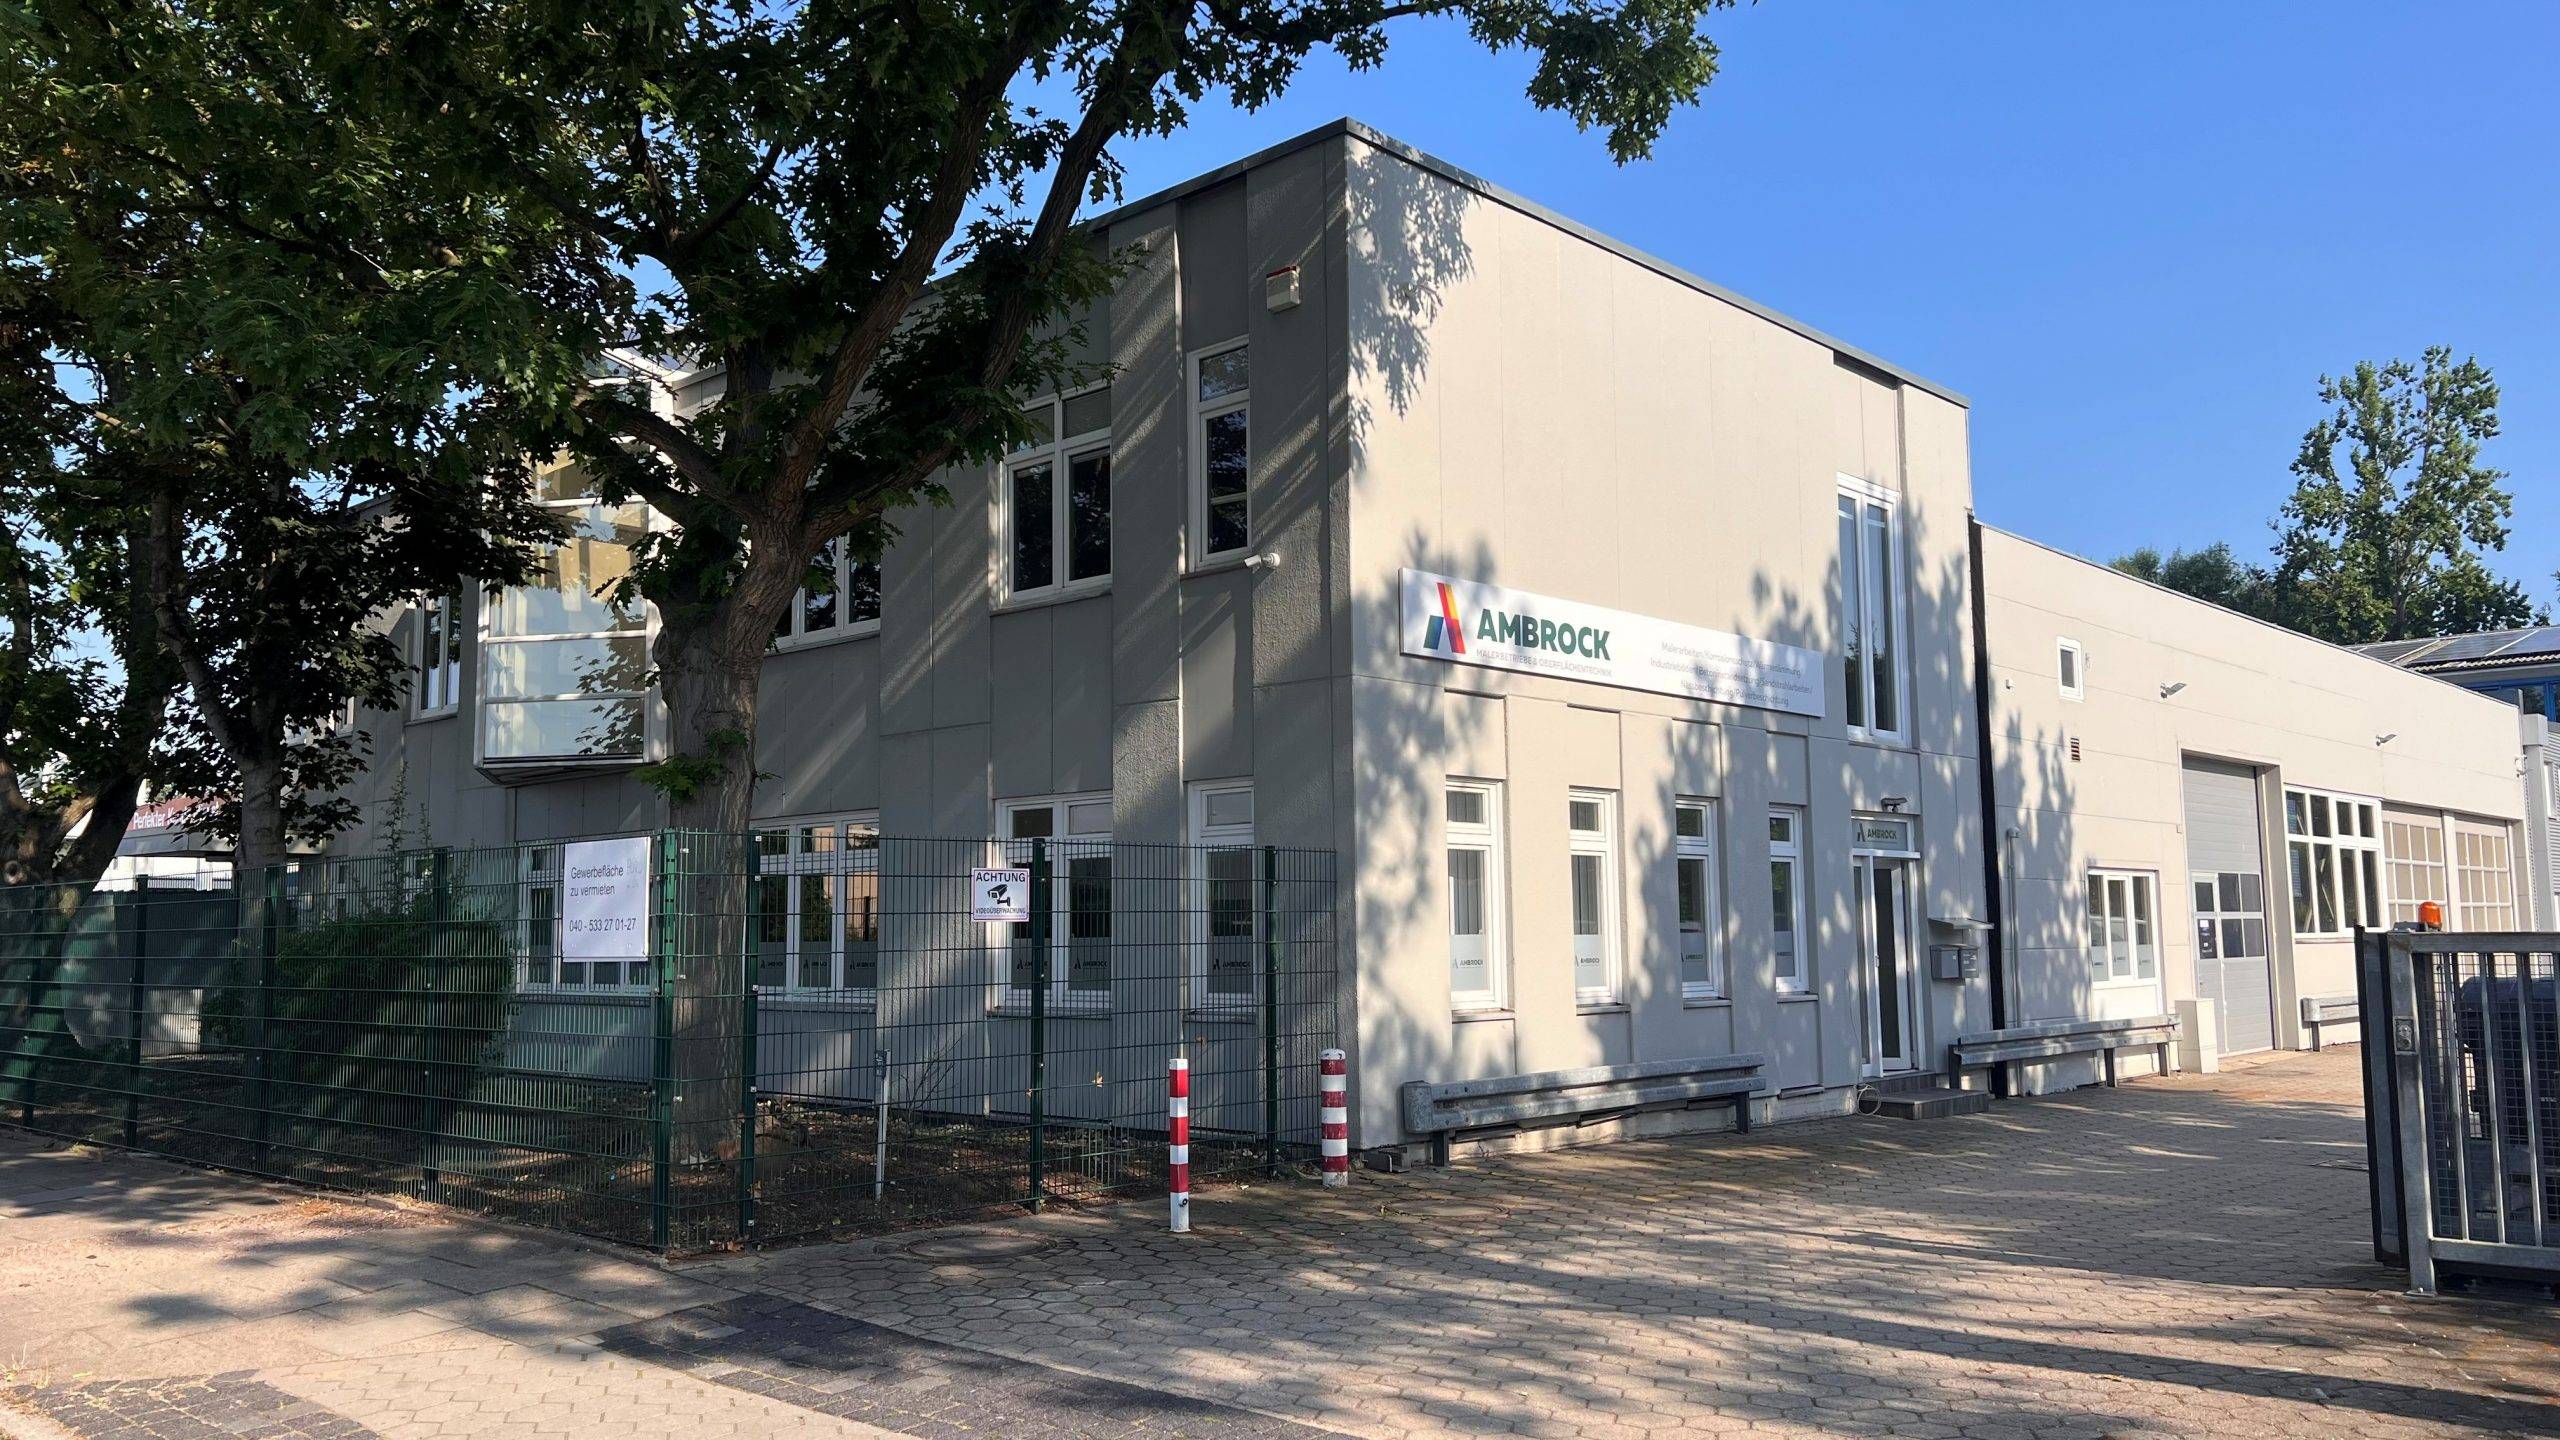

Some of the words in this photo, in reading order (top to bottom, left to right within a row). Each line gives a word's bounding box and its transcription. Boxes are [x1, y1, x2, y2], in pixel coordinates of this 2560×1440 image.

[1477, 608, 1610, 661] AMBROCK
[133, 810, 166, 830] Perfekter
[1867, 828, 1897, 840] AMBROCK
[571, 865, 624, 879] Gewerbefläche
[976, 872, 1025, 882] ACHTUNG
[570, 887, 579, 897] zu
[581, 884, 615, 896] vermieten
[975, 907, 1026, 915] VIDEOÜBERWACHUNG
[569, 919, 583, 932] 040
[589, 919, 603, 932] 533
[604, 918, 614, 931] 27
[615, 918, 637, 931] 01-27
